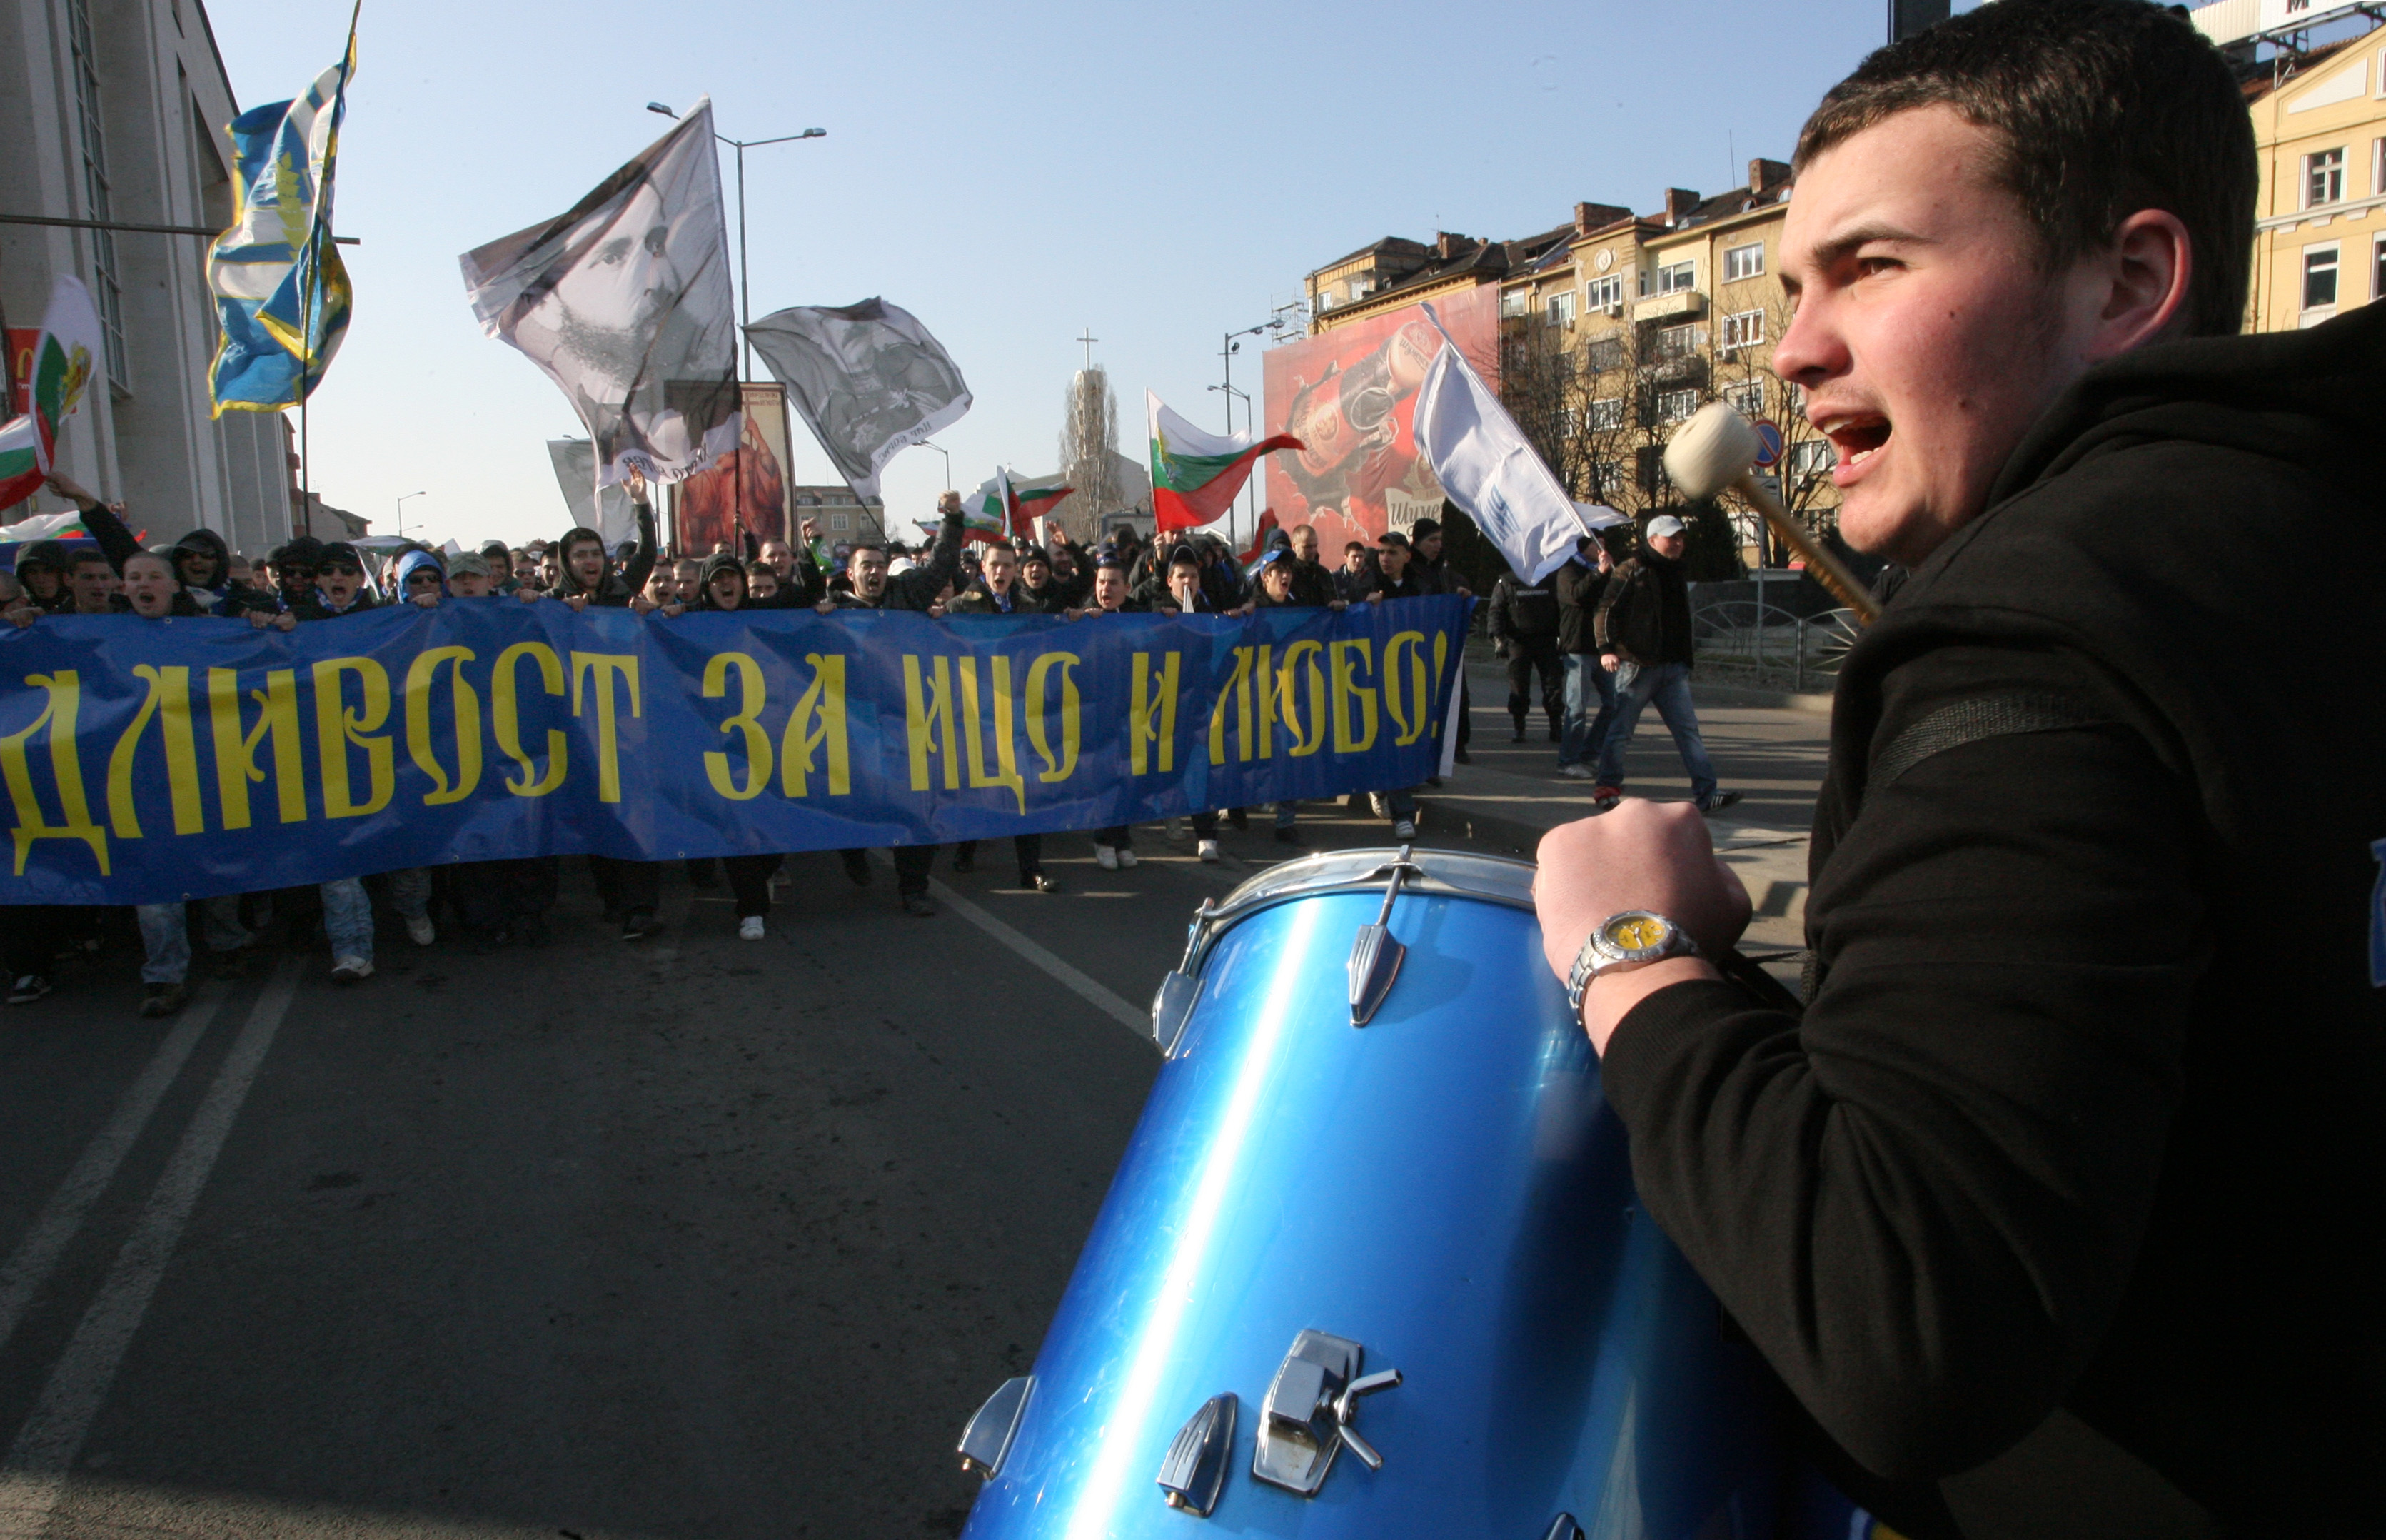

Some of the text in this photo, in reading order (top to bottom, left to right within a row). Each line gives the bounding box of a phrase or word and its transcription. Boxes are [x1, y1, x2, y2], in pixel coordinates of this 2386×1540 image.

[703, 652, 850, 800] ЗА
[902, 652, 1081, 816] ИЦО
[1131, 651, 1180, 776] И
[1209, 630, 1448, 766] ЛЮБО!
